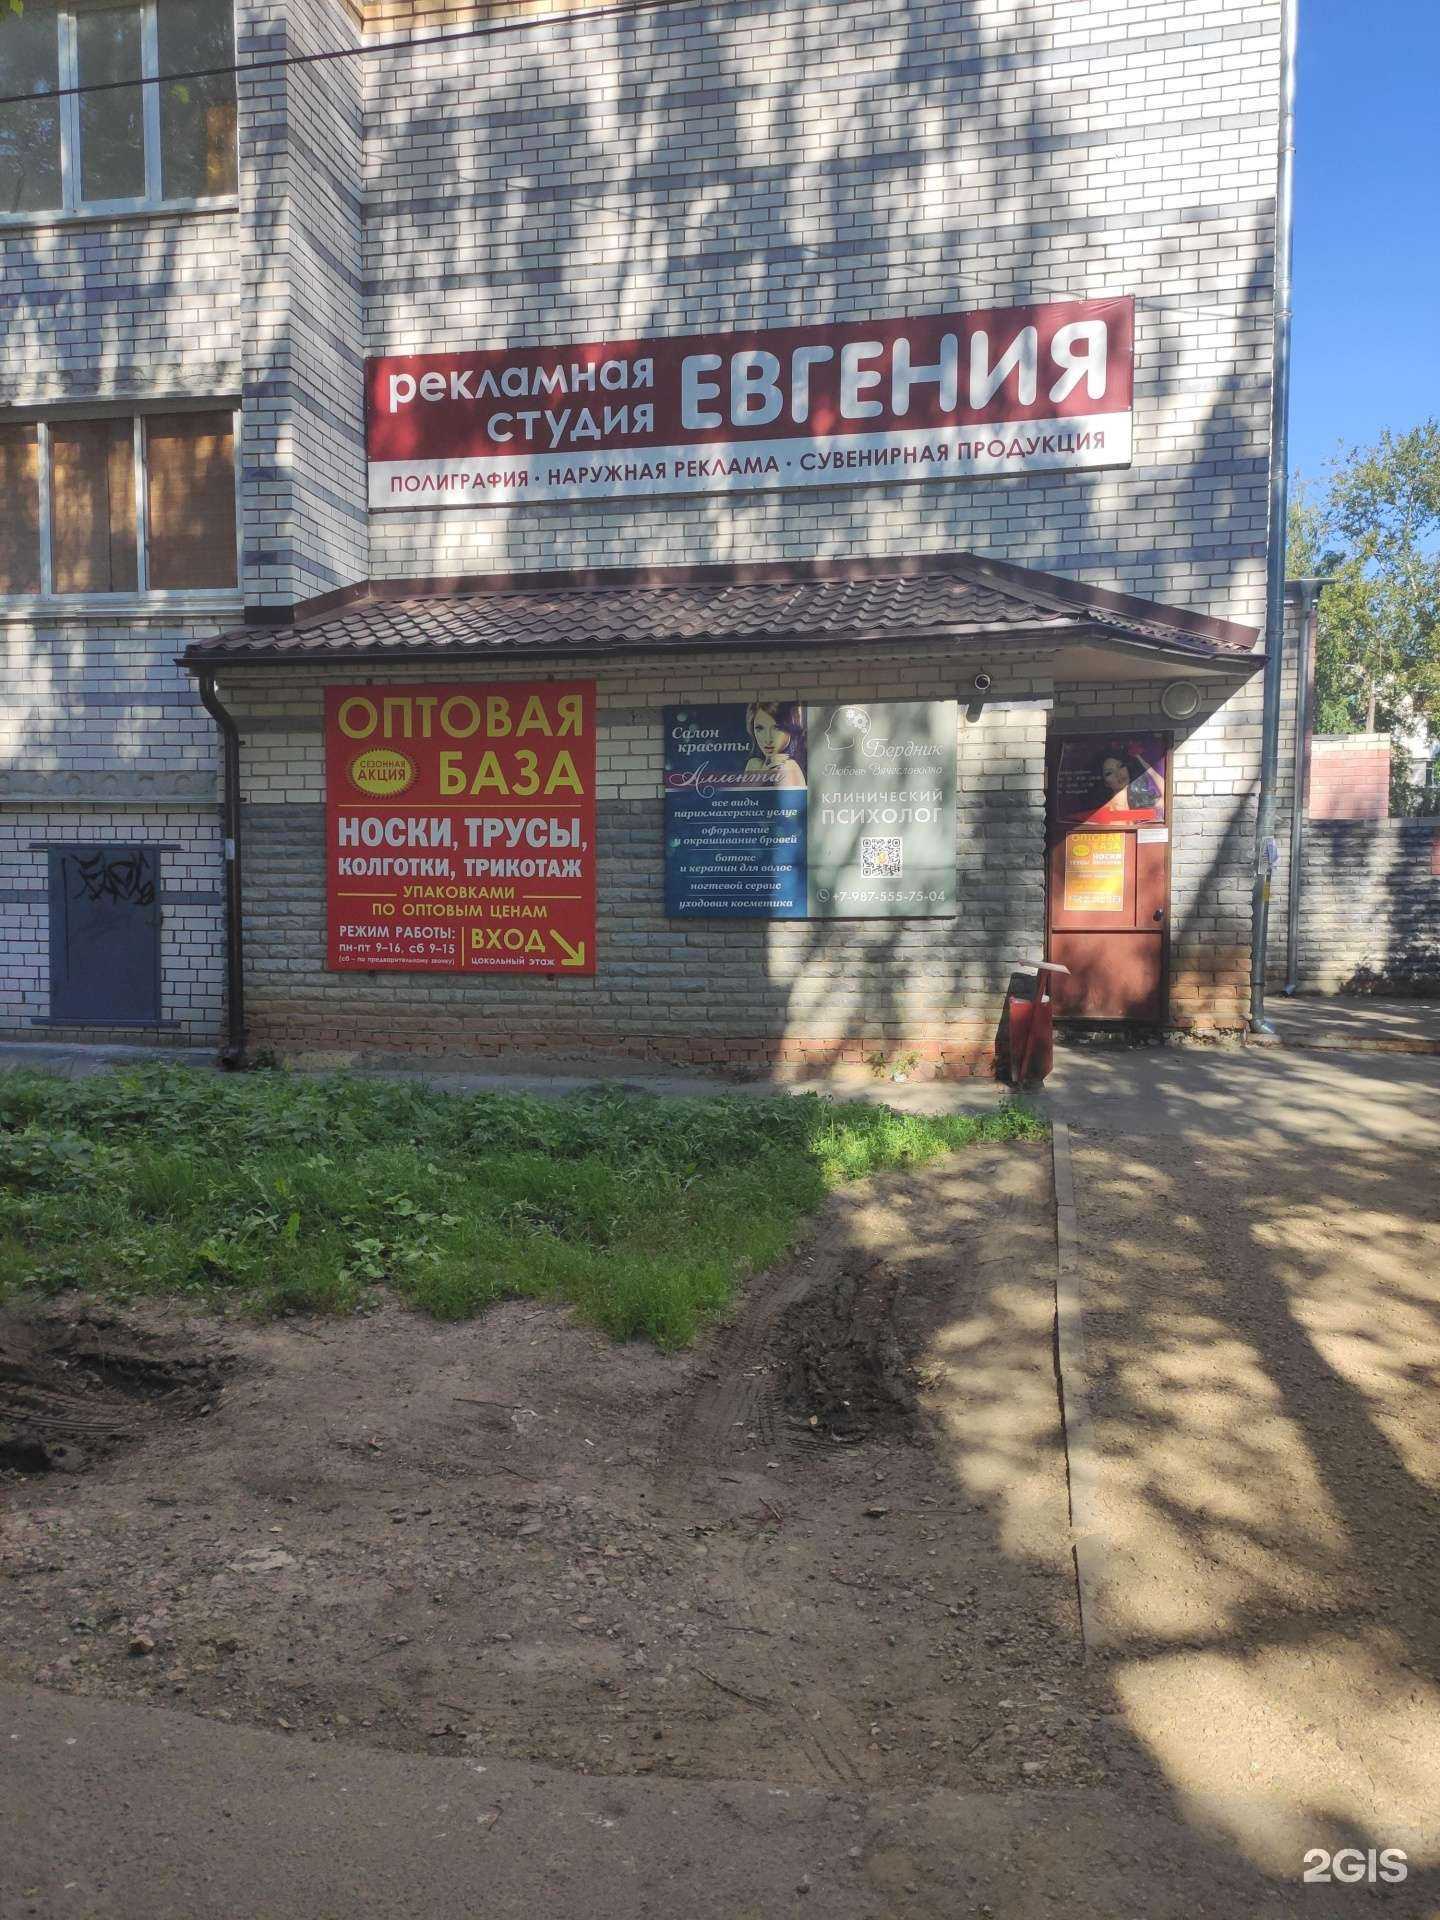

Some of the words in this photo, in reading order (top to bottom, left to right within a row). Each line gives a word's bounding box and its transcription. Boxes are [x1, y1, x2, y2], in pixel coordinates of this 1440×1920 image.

[681, 319, 1108, 430] ЕВГЕНИЯ
[389, 357, 654, 413] рекламная
[487, 403, 654, 448] студия
[390, 470, 529, 493] ПОЛИГРАФИЯ
[548, 462, 667, 486] НАРУЖНАЯ
[674, 455, 779, 478] РЕКЛАМА
[799, 443, 949, 471] СУВЕНИРНАЯ
[958, 431, 1105, 459] ПРОДУКЦИЯ
[338, 694, 583, 739] ОПТОВАЯ
[671, 725, 720, 740] Салон
[677, 740, 750, 756] красоты
[360, 760, 405, 768] СЕЗОННАЯ
[358, 768, 406, 782] АКЦИЯ
[439, 749, 585, 796] БАЗА
[730, 798, 759, 807] виды
[821, 788, 944, 805] КЛИНИЧЕСКИЙ
[674, 809, 765, 819] парикмахерских
[766, 808, 798, 819] услуг
[821, 807, 943, 825] ПСИХОЛОГ
[338, 817, 458, 851] НОСКИ,
[464, 817, 588, 852] ТРУСЫ,
[701, 825, 770, 836] оформление
[683, 837, 758, 846] окрашивание
[759, 835, 798, 846] бровей
[715, 853, 757, 862] ботокс
[338, 857, 456, 880] КОЛГОТКИ,
[463, 858, 582, 878] ТРИКОТАЖ
[689, 864, 737, 874] кератин
[739, 863, 759, 872] для
[761, 864, 793, 872] волос
[403, 885, 515, 899] УПАКОВКАМИ
[690, 881, 743, 890] ногтевой
[745, 882, 782, 892] сервис
[372, 903, 395, 916] ПО
[402, 904, 483, 917] ОПТОВЫМ
[490, 905, 548, 918] ЦЕНАМ
[731, 899, 793, 908] косметика
[339, 925, 390, 938] РЕЖИМ
[395, 926, 456, 939] РАБОТЫ:
[471, 928, 546, 953] ВХОД
[339, 943, 371, 952] пн-пт
[408, 943, 425, 953] сб
[471, 955, 525, 966] цокольный
[528, 957, 555, 966] этаж
